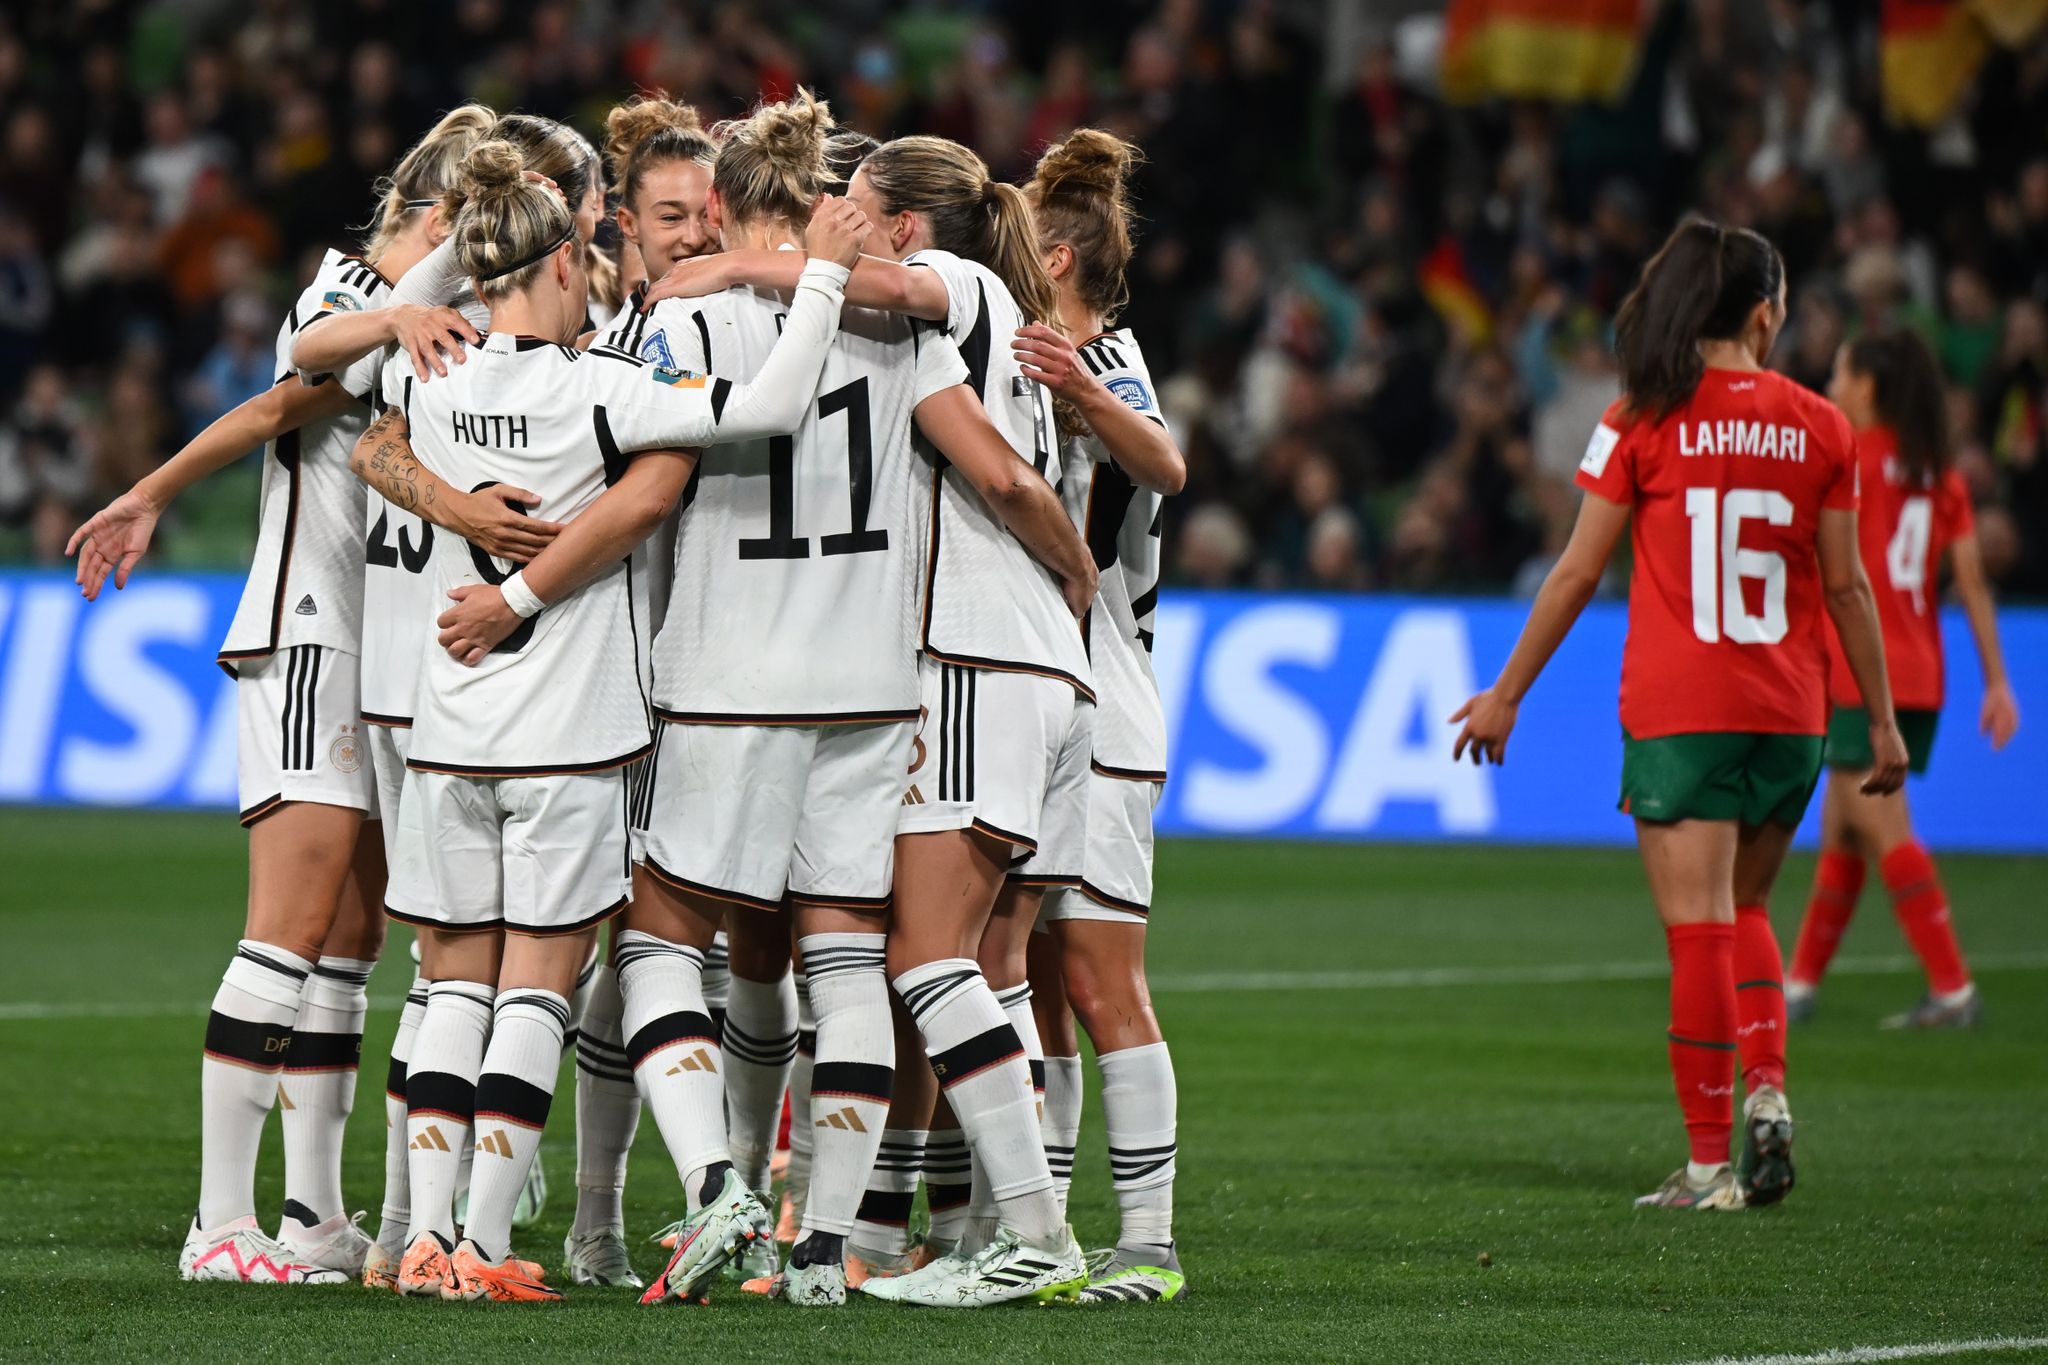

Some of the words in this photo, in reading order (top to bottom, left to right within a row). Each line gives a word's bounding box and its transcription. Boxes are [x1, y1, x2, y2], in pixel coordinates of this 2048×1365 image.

[452, 410, 528, 448] HUTH
[739, 376, 889, 560] 11
[1679, 419, 1807, 464] LAHMARI
[1686, 487, 1794, 645] 16
[1886, 496, 1933, 617] 4
[264, 1036, 291, 1053] DF
